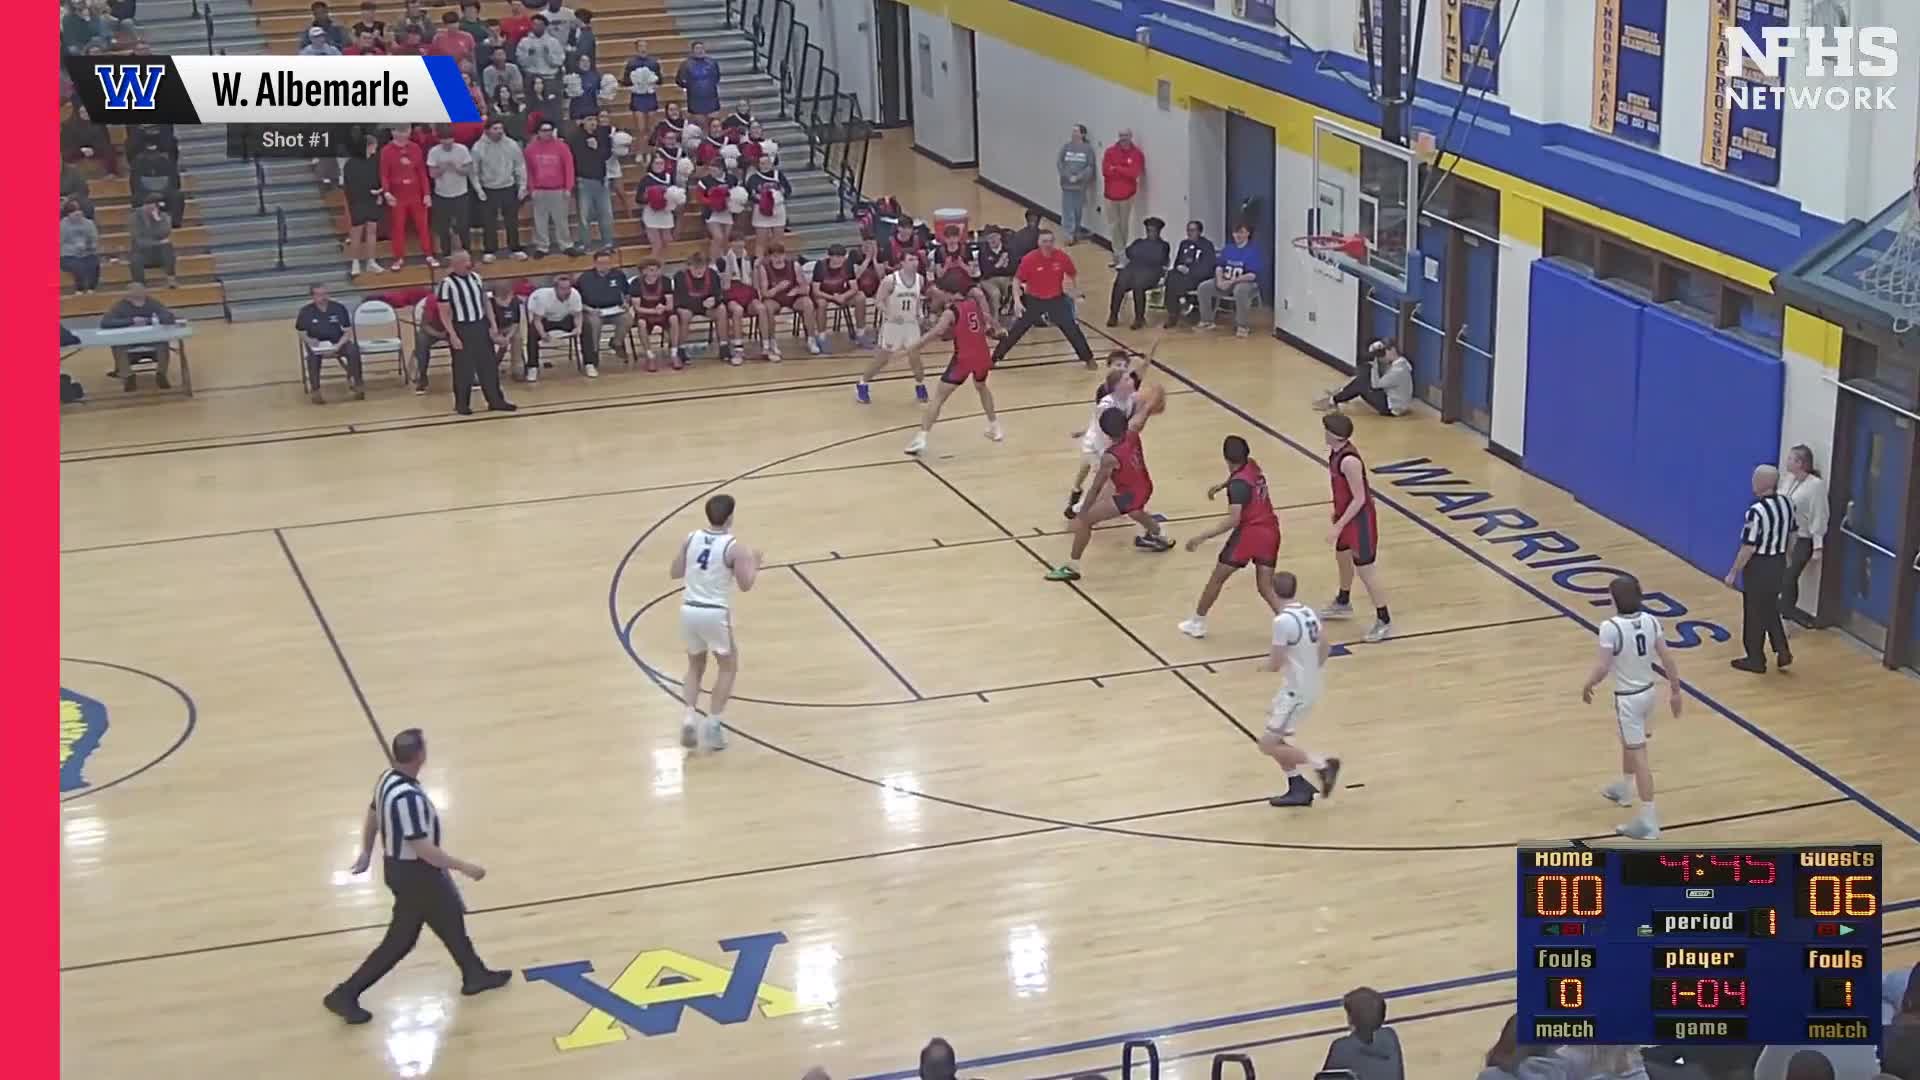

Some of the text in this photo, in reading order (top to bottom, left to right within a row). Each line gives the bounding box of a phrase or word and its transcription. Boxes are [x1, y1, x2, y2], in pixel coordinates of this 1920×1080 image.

[901, 299, 911, 311] 11
[967, 311, 980, 333] 5
[696, 548, 711, 571] 4
[1635, 633, 1647, 657] 0
